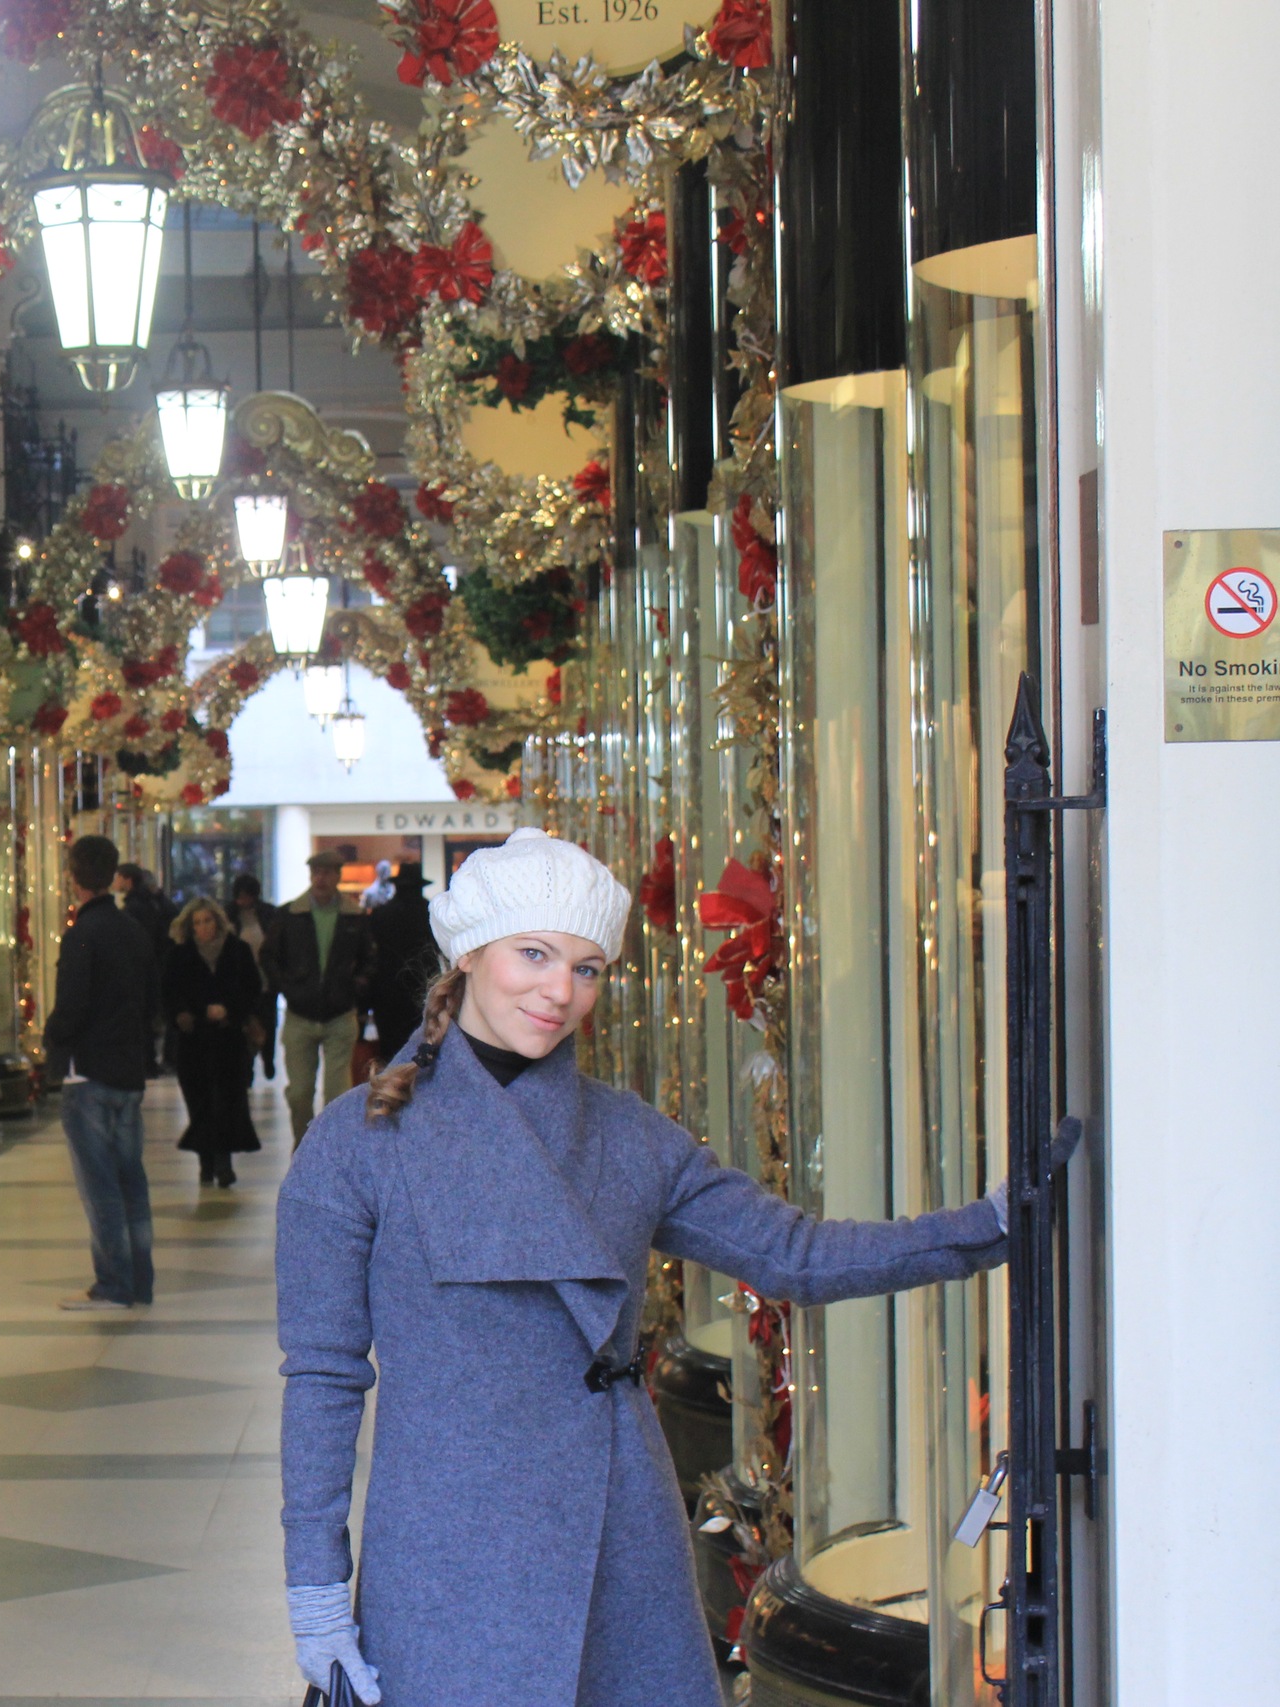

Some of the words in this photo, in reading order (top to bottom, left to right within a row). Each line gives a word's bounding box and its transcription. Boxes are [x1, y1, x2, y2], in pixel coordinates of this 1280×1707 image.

[538, 1, 588, 25] Est.
[603, 0, 658, 22] 1926
[1179, 661, 1207, 677] No
[1214, 659, 1280, 676] Smoki
[1188, 685, 1196, 693] It
[1198, 684, 1207, 693] is
[1209, 684, 1245, 694] against
[1247, 684, 1263, 692] the
[1180, 696, 1213, 704] smoke
[1215, 695, 1225, 703] in
[1227, 695, 1254, 703] these
